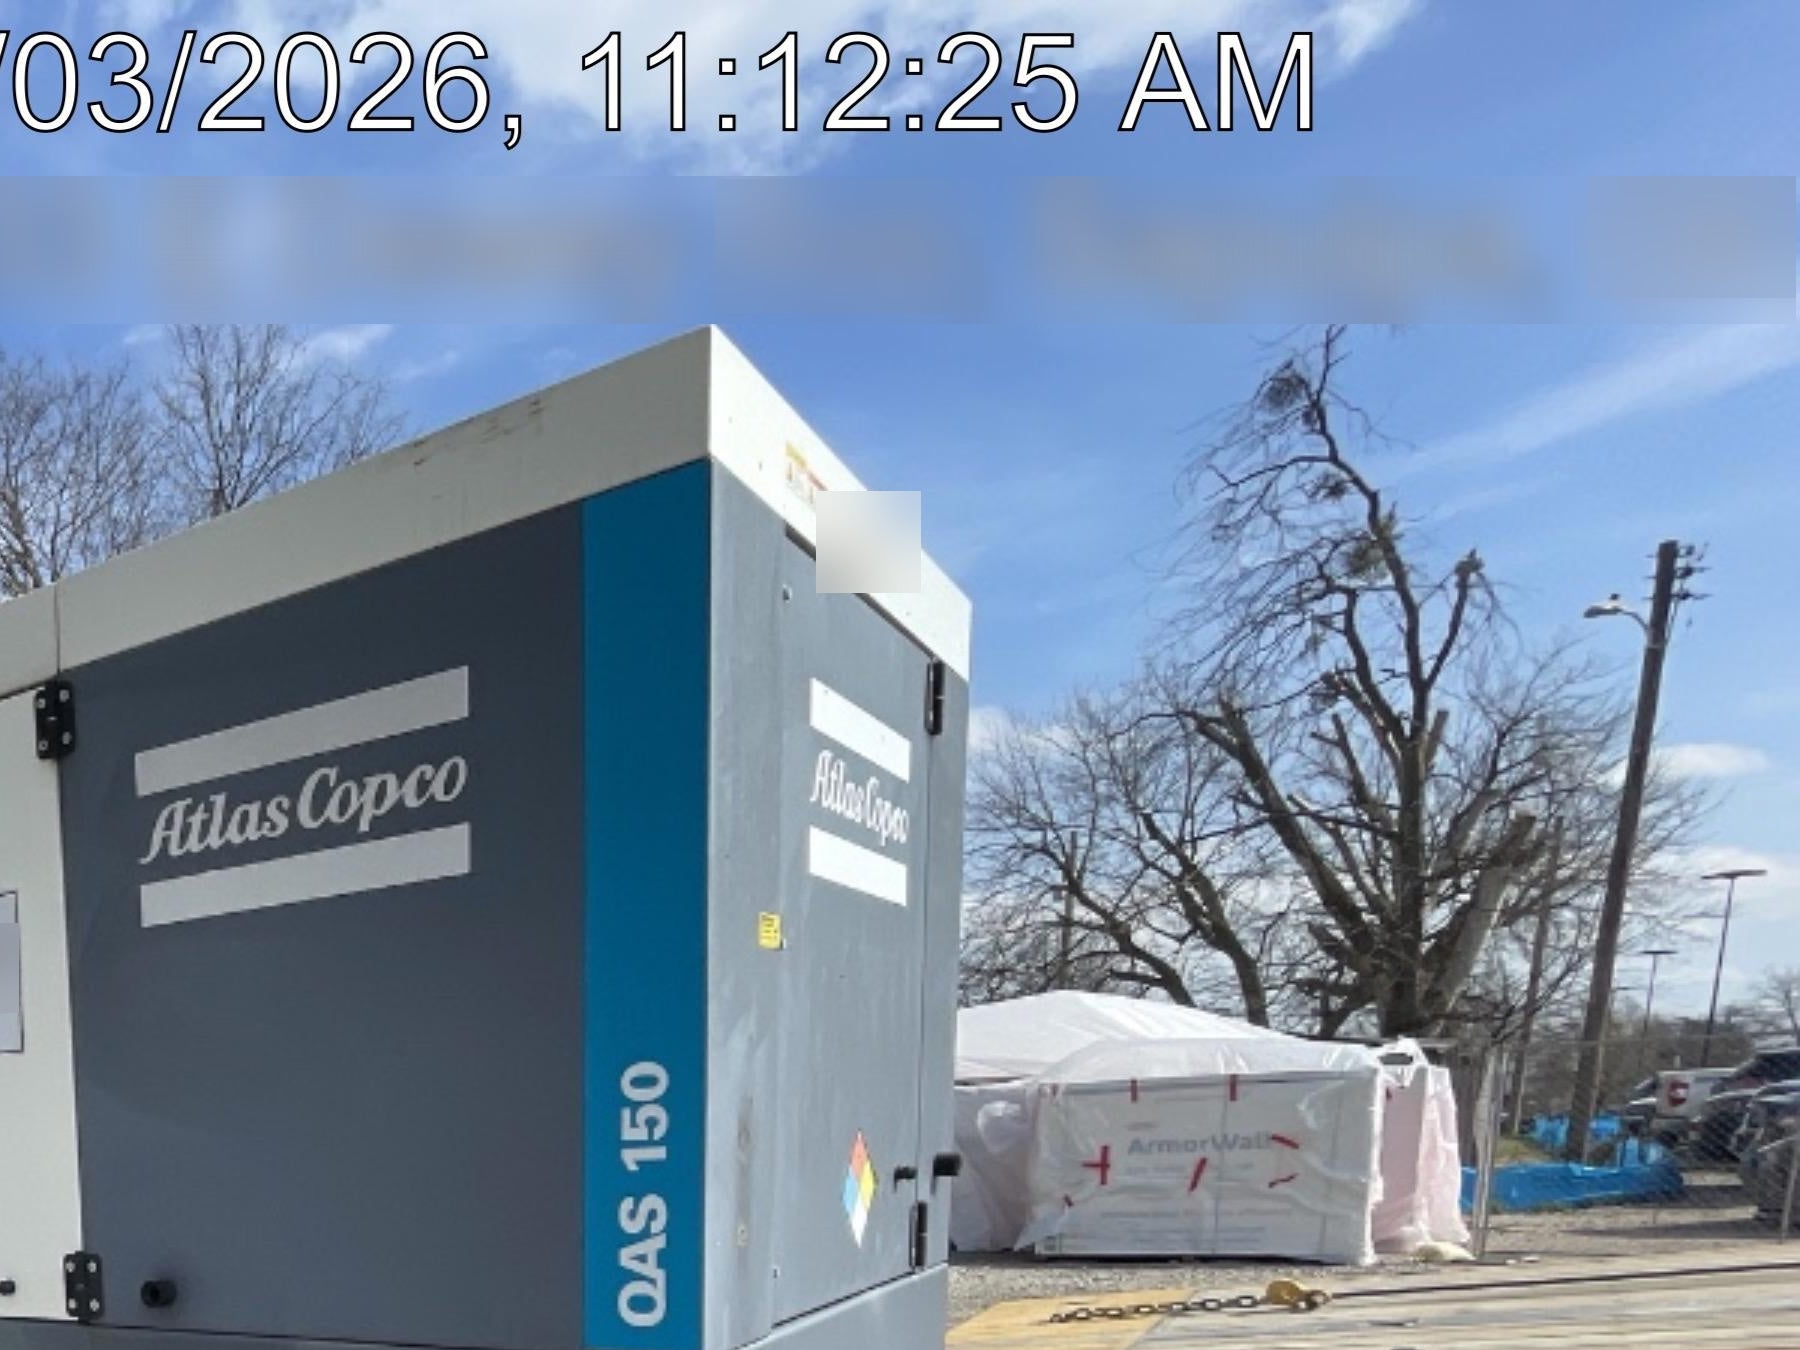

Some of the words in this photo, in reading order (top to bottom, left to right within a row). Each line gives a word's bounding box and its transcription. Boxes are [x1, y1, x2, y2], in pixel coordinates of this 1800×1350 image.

[138, 792, 289, 865] Atlas
[296, 756, 468, 833] Copco
[809, 749, 865, 823] Atlas
[865, 776, 910, 847] Copco
[620, 1061, 670, 1171] 150
[617, 1194, 667, 1327] QAS
